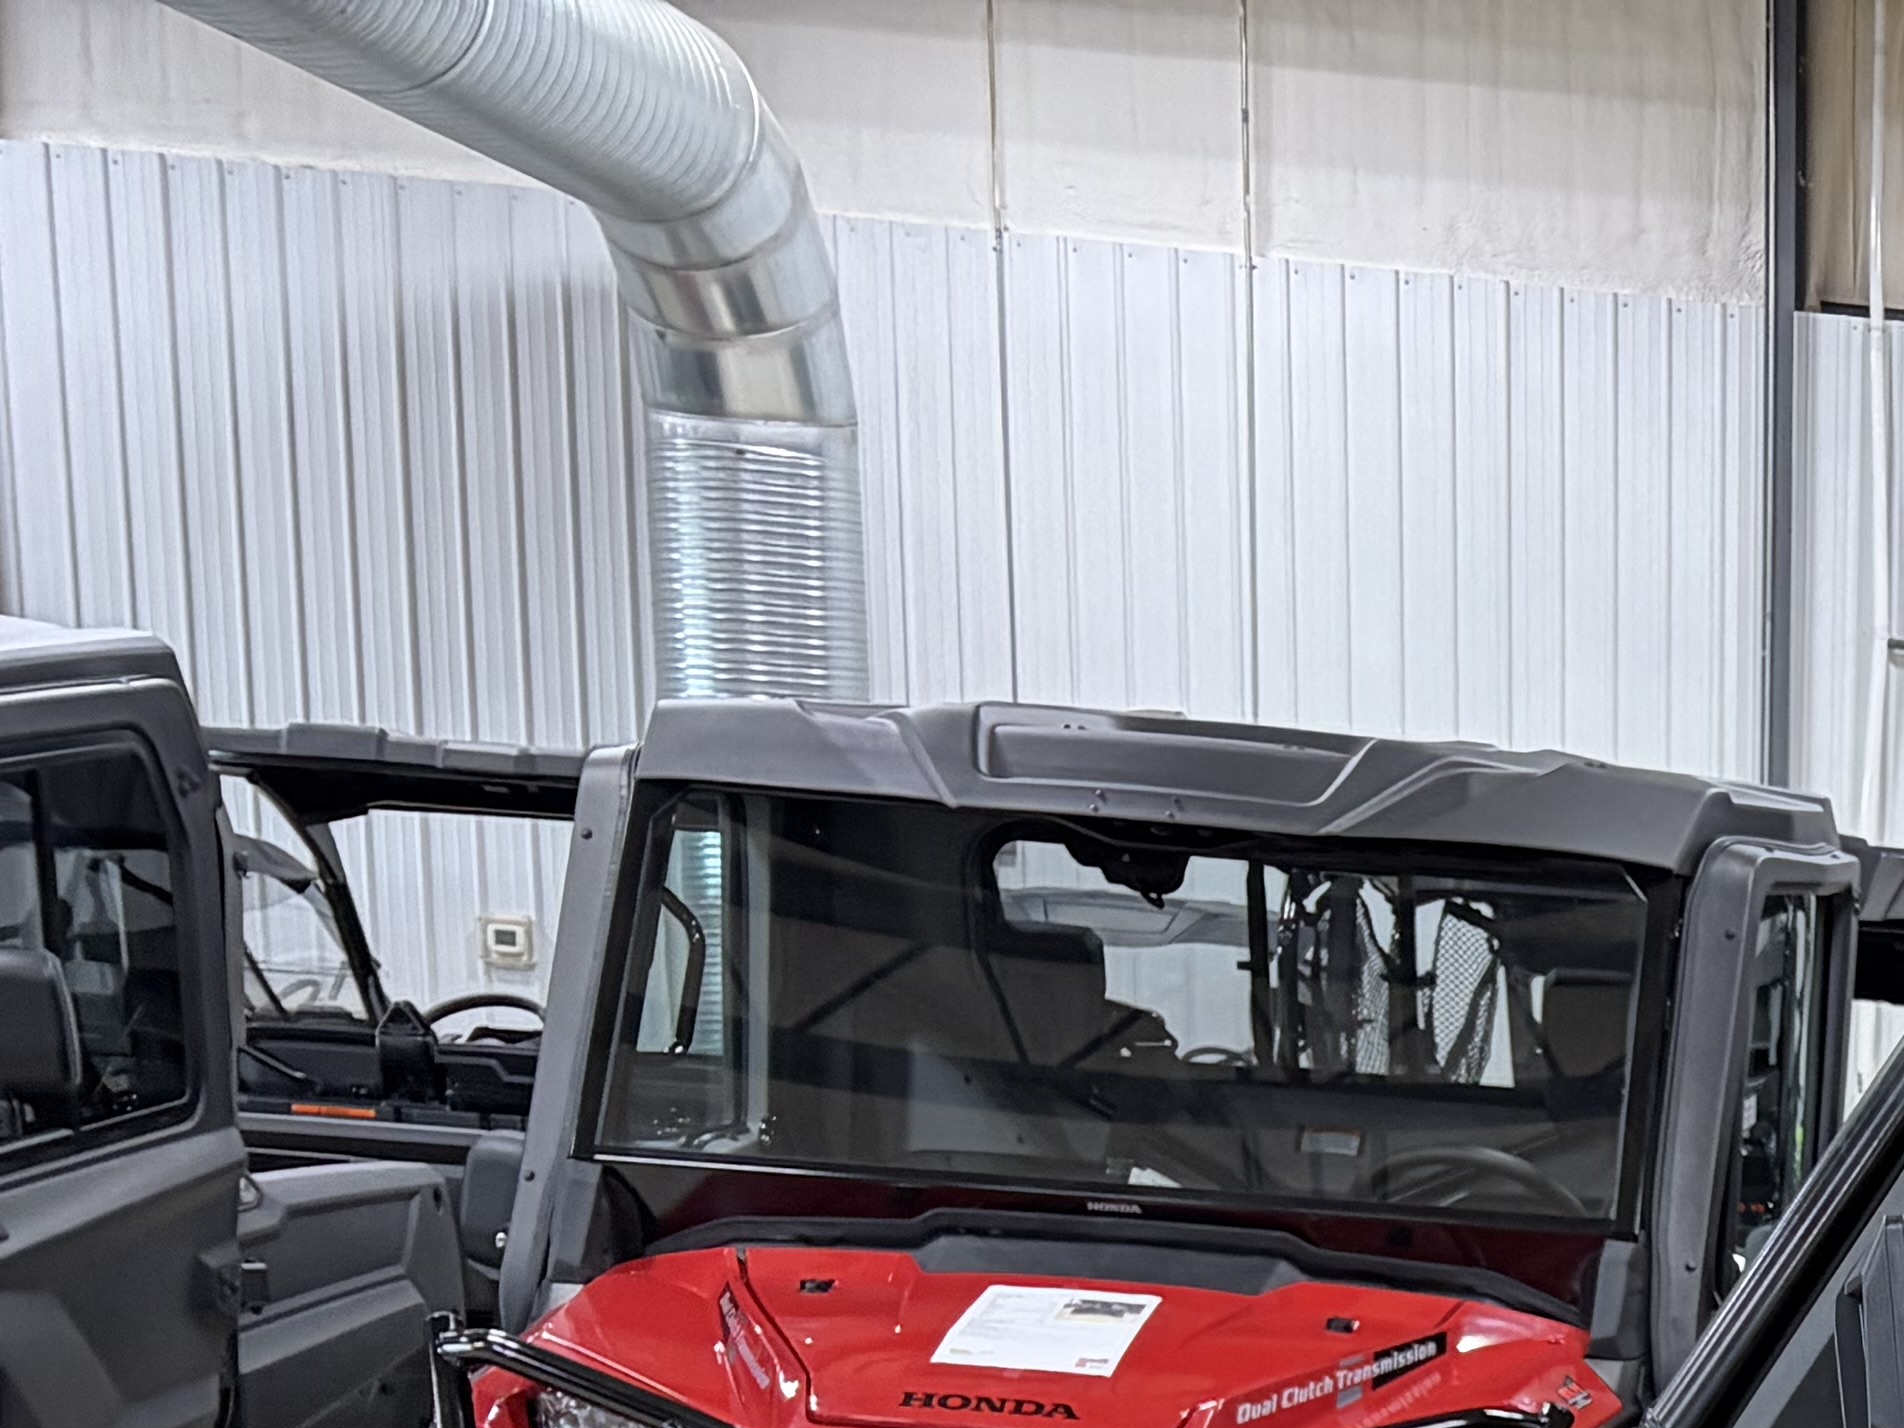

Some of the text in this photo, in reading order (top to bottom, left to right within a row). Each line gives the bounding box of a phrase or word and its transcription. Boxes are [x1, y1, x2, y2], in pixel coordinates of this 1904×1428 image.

[898, 1391, 1081, 1420] HONDA
[1236, 1394, 1277, 1424] Dual
[1281, 1374, 1334, 1406] Clutch
[1336, 1340, 1438, 1389] Transmission
